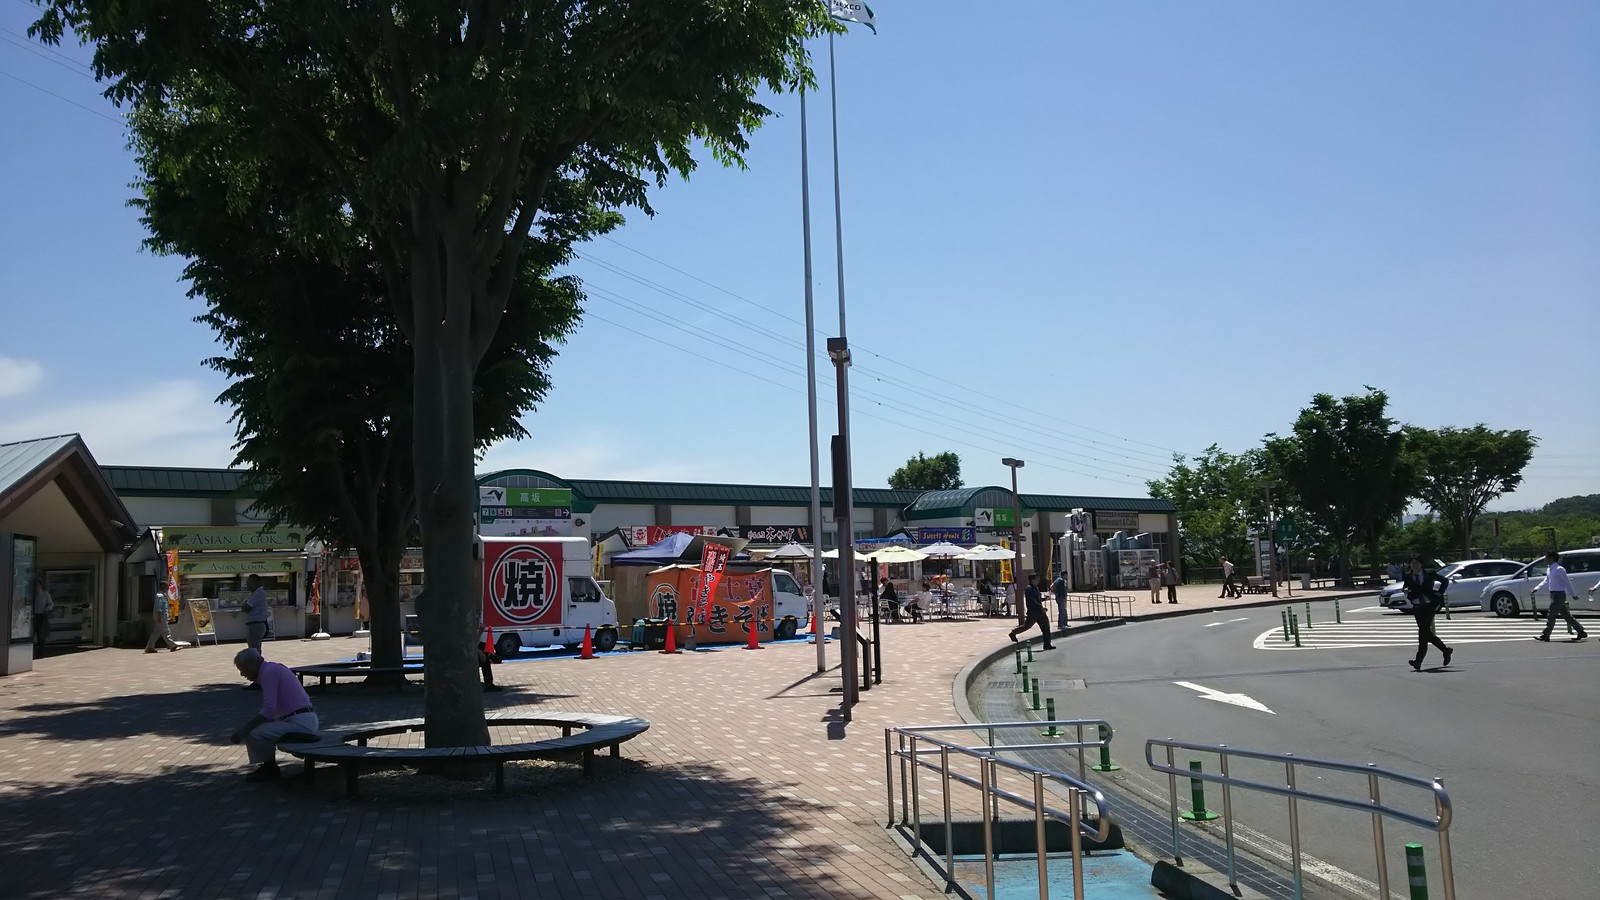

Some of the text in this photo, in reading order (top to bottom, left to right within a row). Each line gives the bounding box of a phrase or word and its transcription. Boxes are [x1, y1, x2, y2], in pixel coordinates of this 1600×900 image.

[833, 0, 861, 10] NEXCO
[520, 492, 540, 502] 高坂
[190, 533, 281, 545] ASIAN COOK
[210, 563, 267, 571] ASIAN COOK
[502, 559, 546, 609] 焼
